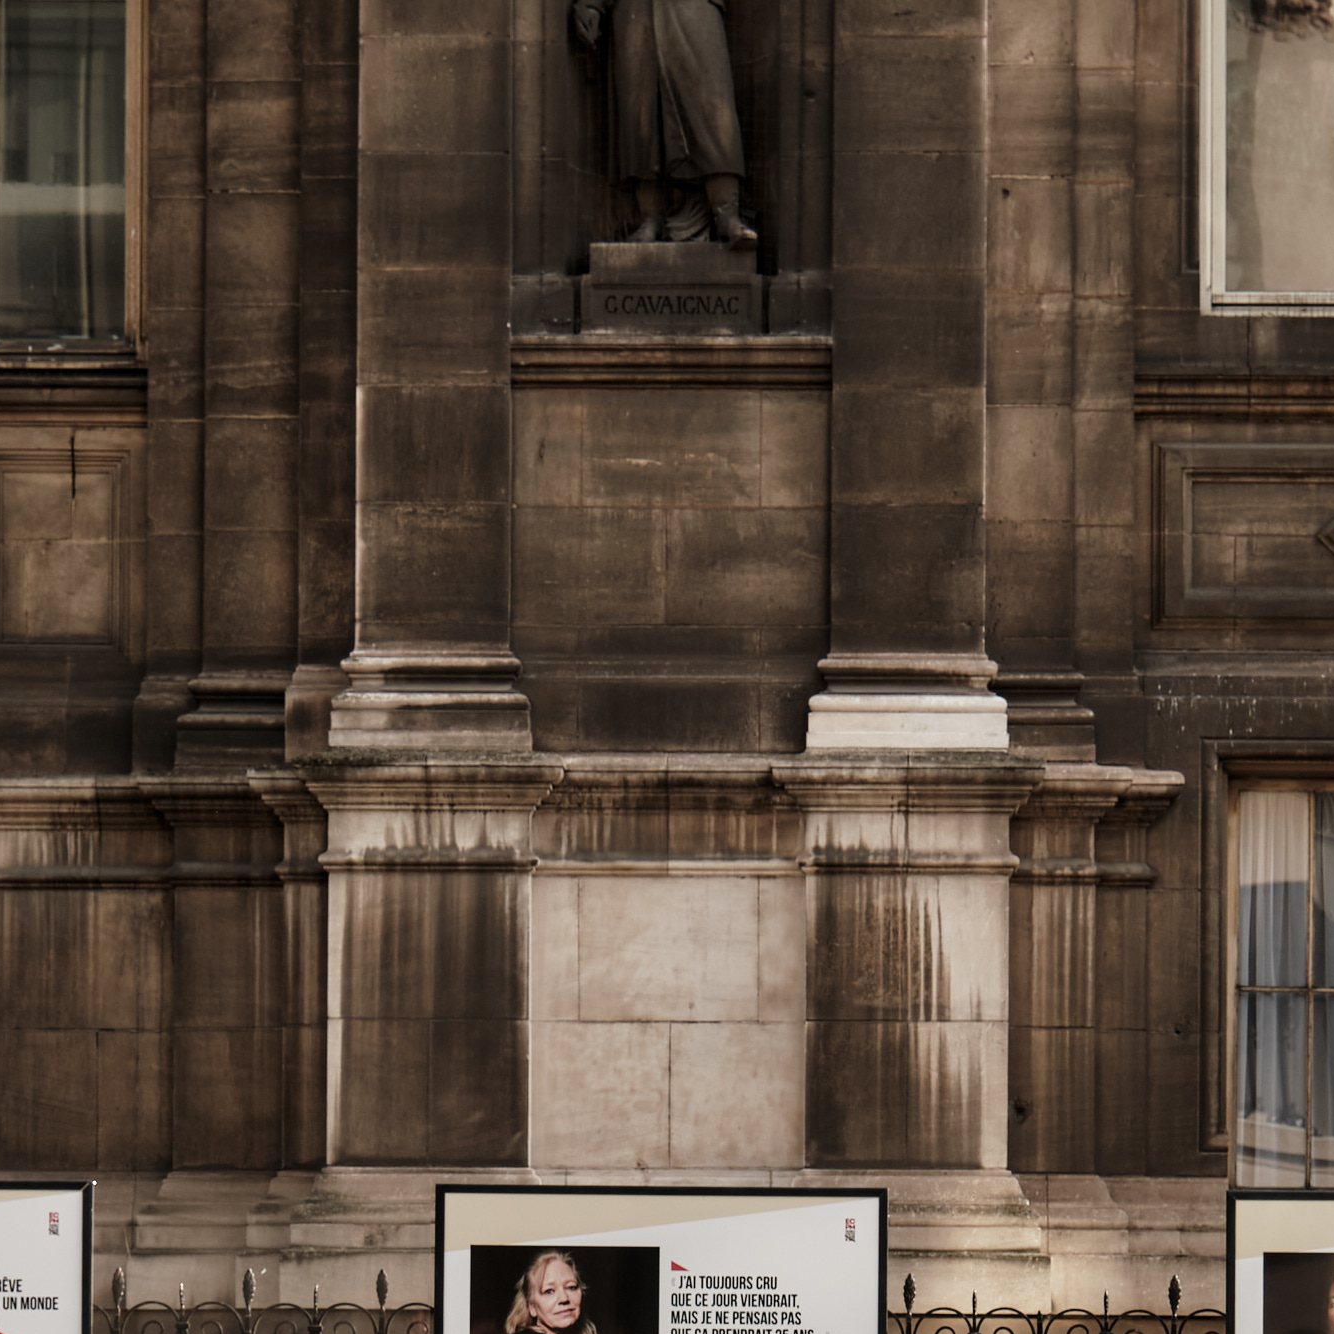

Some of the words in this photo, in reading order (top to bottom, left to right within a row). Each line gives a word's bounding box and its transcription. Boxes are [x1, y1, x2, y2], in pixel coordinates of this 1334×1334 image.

[678, 1276, 696, 1289] J'AI
[700, 1276, 753, 1289] TOUJOURS
[756, 1277, 778, 1289] CRU
[2, 1297, 18, 1310] UN
[20, 1297, 59, 1310] MONDE
[671, 1293, 692, 1307] QUE
[695, 1294, 708, 1307] CE
[711, 1294, 738, 1307] JOUR
[741, 1294, 800, 1310] VIENDRAIT,
[670, 1311, 698, 1324] MAIS
[701, 1311, 712, 1324] JE
[715, 1311, 729, 1324] NE
[732, 1312, 778, 1325] PENSAIS
[781, 1312, 802, 1325] PAS
